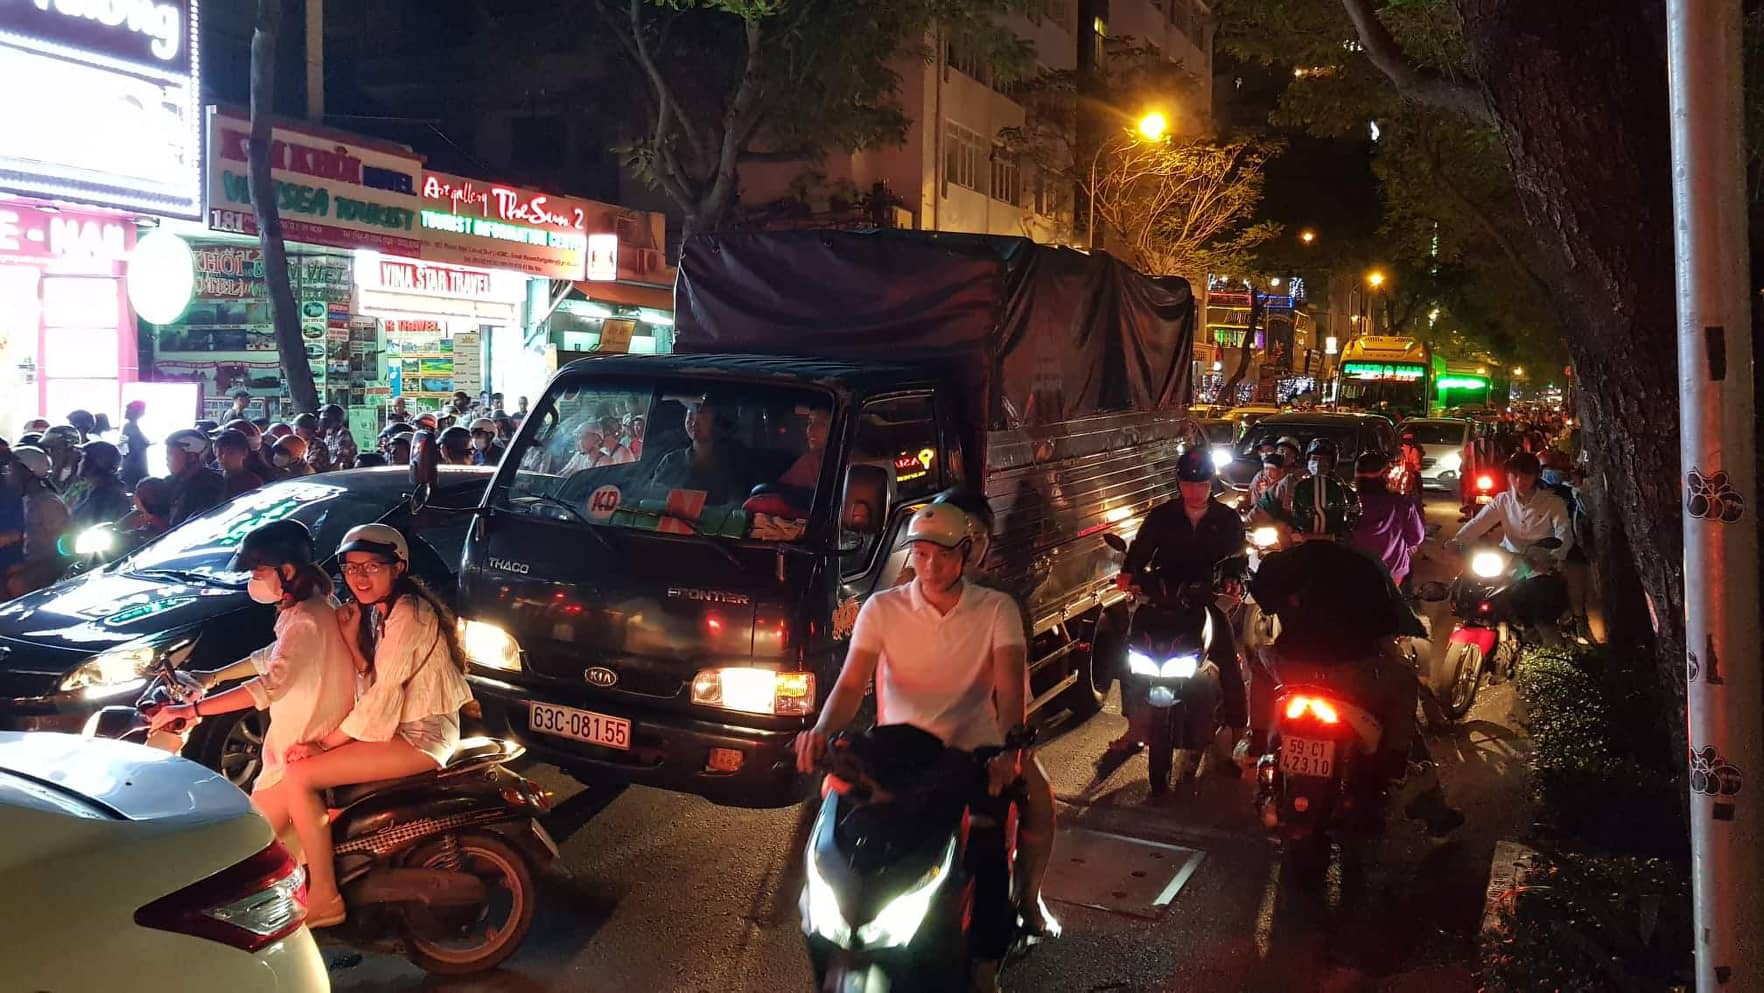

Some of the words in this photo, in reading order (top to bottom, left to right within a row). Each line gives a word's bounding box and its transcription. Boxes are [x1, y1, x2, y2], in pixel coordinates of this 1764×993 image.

[574, 208, 585, 230] 2
[415, 267, 448, 292] STAR
[489, 557, 529, 574] THACO
[667, 587, 749, 605] FRONTIER
[589, 670, 612, 684] KIA
[533, 705, 627, 746] 63C-081.55
